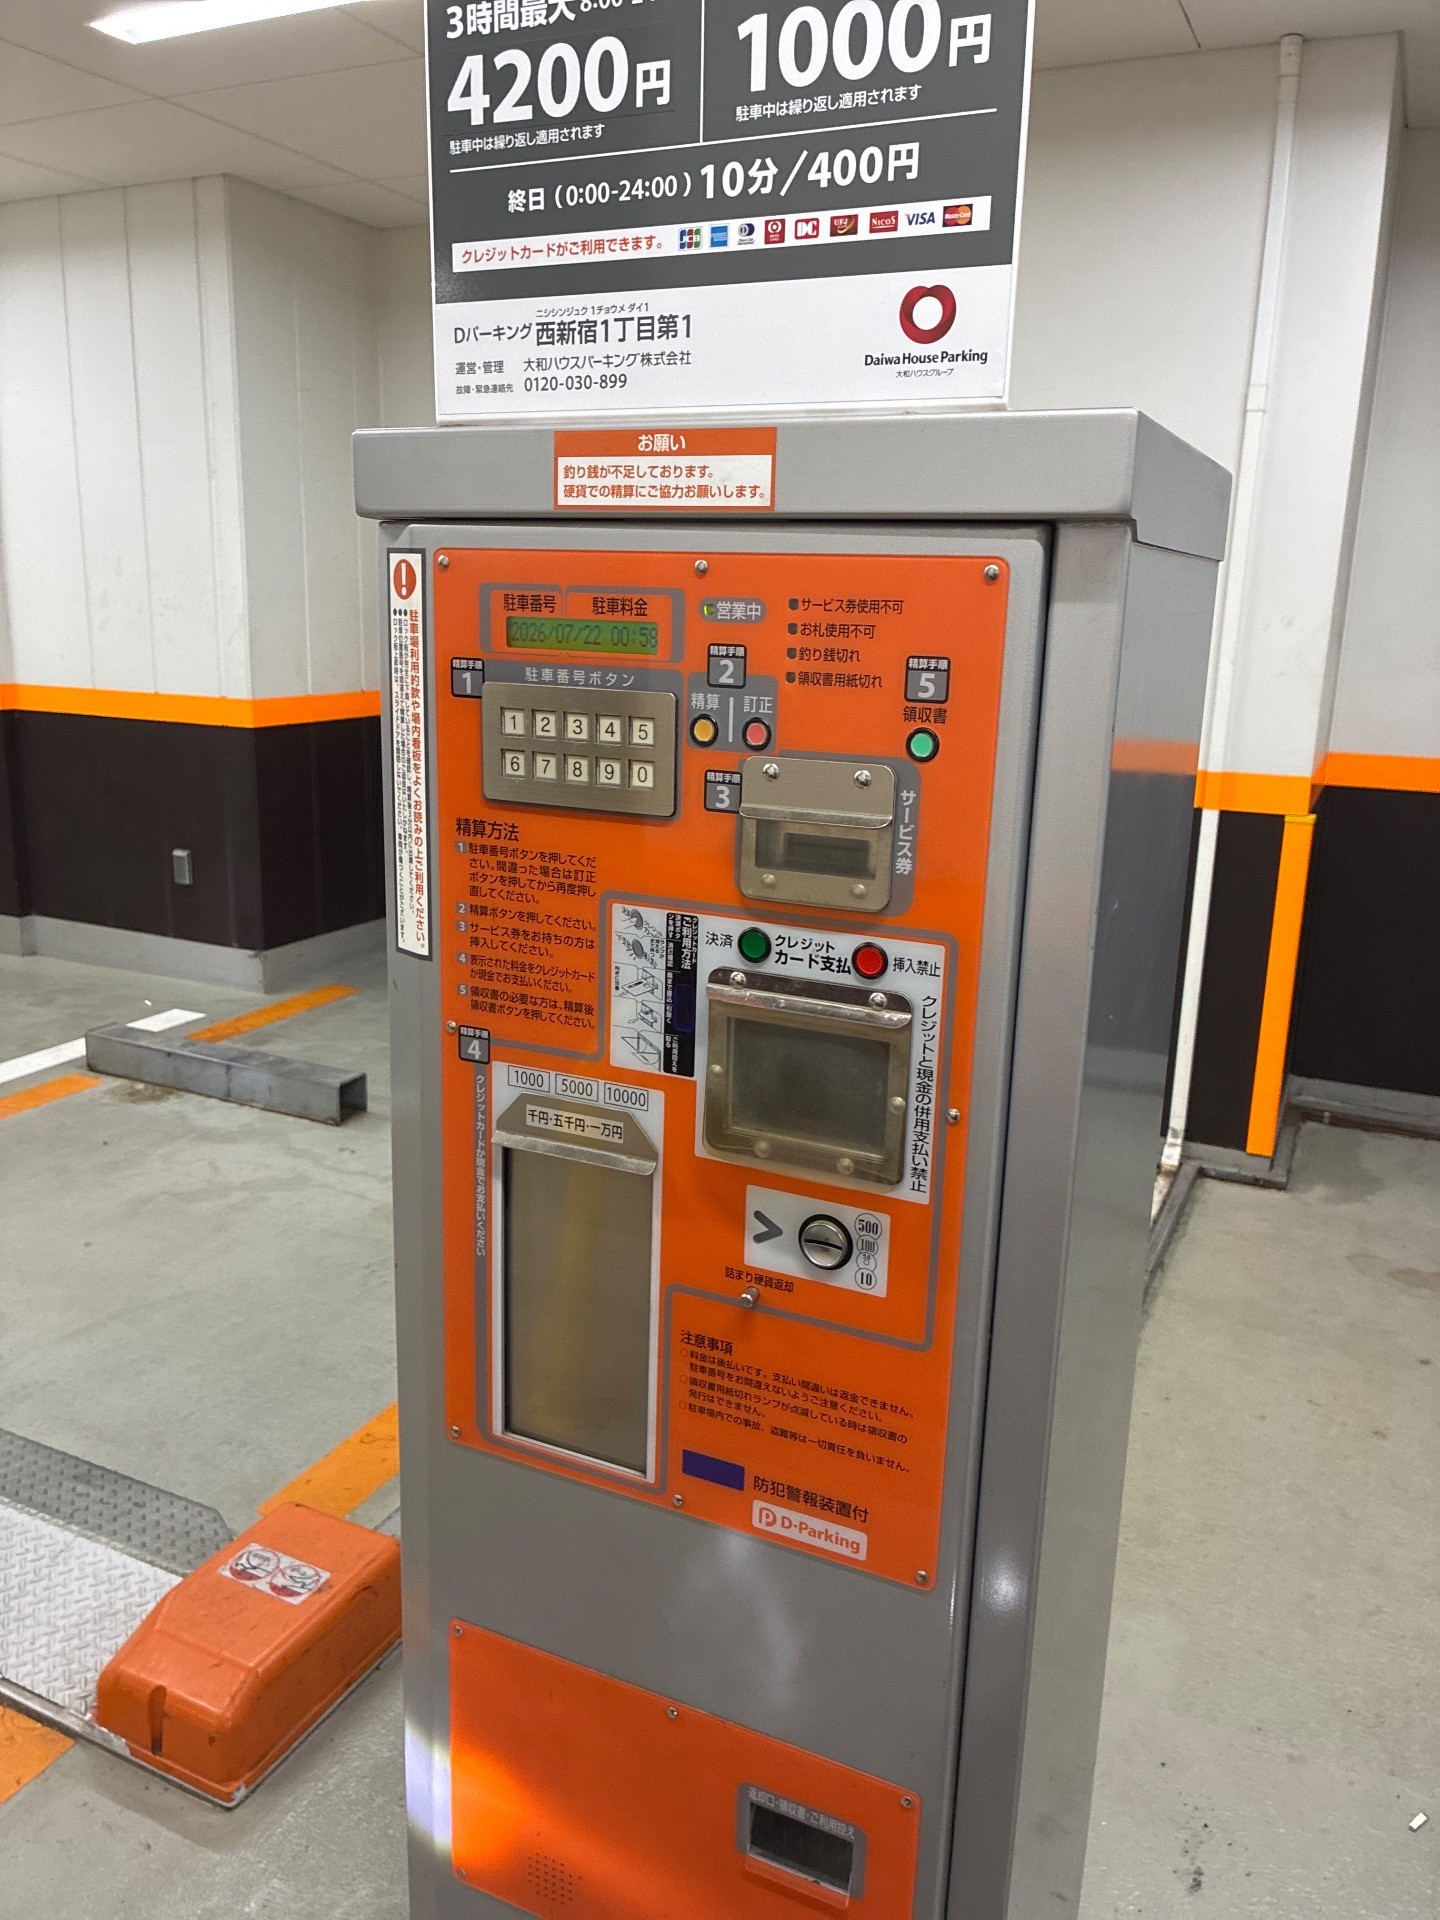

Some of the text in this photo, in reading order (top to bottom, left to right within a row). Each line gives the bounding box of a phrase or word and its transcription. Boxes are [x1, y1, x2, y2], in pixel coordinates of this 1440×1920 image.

[446, 0, 576, 39] 3時間最大
[737, 0, 992, 92] 1000円
[447, 36, 671, 126] 4200円
[735, 84, 922, 122] 駐車中は繰り返し適用されます
[449, 123, 606, 155] 駐車中は繰り返し適用されます
[795, 219, 818, 238] DC
[906, 212, 935, 226] VISA
[461, 234, 663, 264] クレジットカードがご利用できます。
[535, 302, 649, 318] ニシシンジュク 1チョウメ ダイ1
[455, 350, 692, 376] 運営・管理 大和ハウスパーキング株式会社
[864, 349, 988, 366] Daiwa House Parking
[524, 373, 628, 393] 0120-030-899
[895, 368, 955, 378] 大和ハウスグループ
[637, 433, 686, 453] お願い
[563, 464, 714, 480] 釣り銭が不足しております。
[563, 484, 765, 500] 硬貨での精算にご協力お願いします。
[503, 593, 556, 613] 駐車番号
[592, 597, 648, 617] 駐車料金
[716, 601, 762, 621] 営業中
[801, 598, 904, 615] サービス券使用不可
[509, 621, 658, 648] 2026/07/22 00:58
[800, 622, 876, 639] お札使用不可
[709, 646, 745, 657] 精算手順
[798, 646, 861, 663] 釣り銭切れ
[452, 658, 483, 670] 精算手順
[718, 659, 735, 684] 2
[908, 658, 949, 670] 精算手順
[461, 672, 472, 694] 1
[525, 667, 635, 687] 駐車番号ボタン
[797, 671, 883, 689] 領収書用紙切れ
[917, 672, 936, 698] 5
[690, 693, 773, 714] 精算 訂正
[903, 705, 948, 725] 領収書
[510, 715, 648, 740] 1 2 3 4 5
[510, 756, 648, 783] 6 7 8 9 0
[706, 772, 741, 784] 精算手順
[715, 785, 730, 809] 3
[456, 817, 519, 842] 精算方法
[895, 790, 917, 876] サービス券
[468, 842, 597, 869] 駐車番号ボタンを押してくだ
[469, 858, 596, 883] さい。間違った場合は訂正
[469, 872, 597, 898] ボタンを押してから再度押し
[469, 885, 540, 904] 直してください。
[469, 904, 597, 931] 精算ボタンを押してください。
[469, 936, 554, 959] 挿入してください。
[470, 922, 596, 950] サービス券をお持ちの方は
[681, 916, 692, 970] ご利用方法
[705, 931, 734, 949] 決済
[774, 934, 836, 954] クレジット
[469, 954, 596, 983] 表示された料金をクレジットカード
[774, 950, 851, 976] カード支払
[893, 956, 941, 978] 挿入禁止
[470, 968, 573, 994] か現金でお支払いください。
[470, 985, 595, 1016] 領収書の必要な方は、精算後
[470, 999, 596, 1029] 領収書ボタンを押してください。
[467, 1039, 482, 1060] 4
[513, 1070, 646, 1107] 1000 5000 10000
[911, 994, 938, 1194] クレジットと現金の併用支払い禁止
[527, 1108, 623, 1140] 千円・五千円・一万円
[857, 1218, 878, 1236] 500
[860, 1238, 876, 1253] 100
[724, 1266, 794, 1293] 詰まり硬貨返却
[859, 1271, 872, 1287] 10
[680, 1329, 734, 1356] 注意事項
[688, 1388, 766, 1418] 発行はできません。
[753, 1475, 869, 1523] 防犯警報装置付
[780, 1515, 860, 1554] D-Parking
